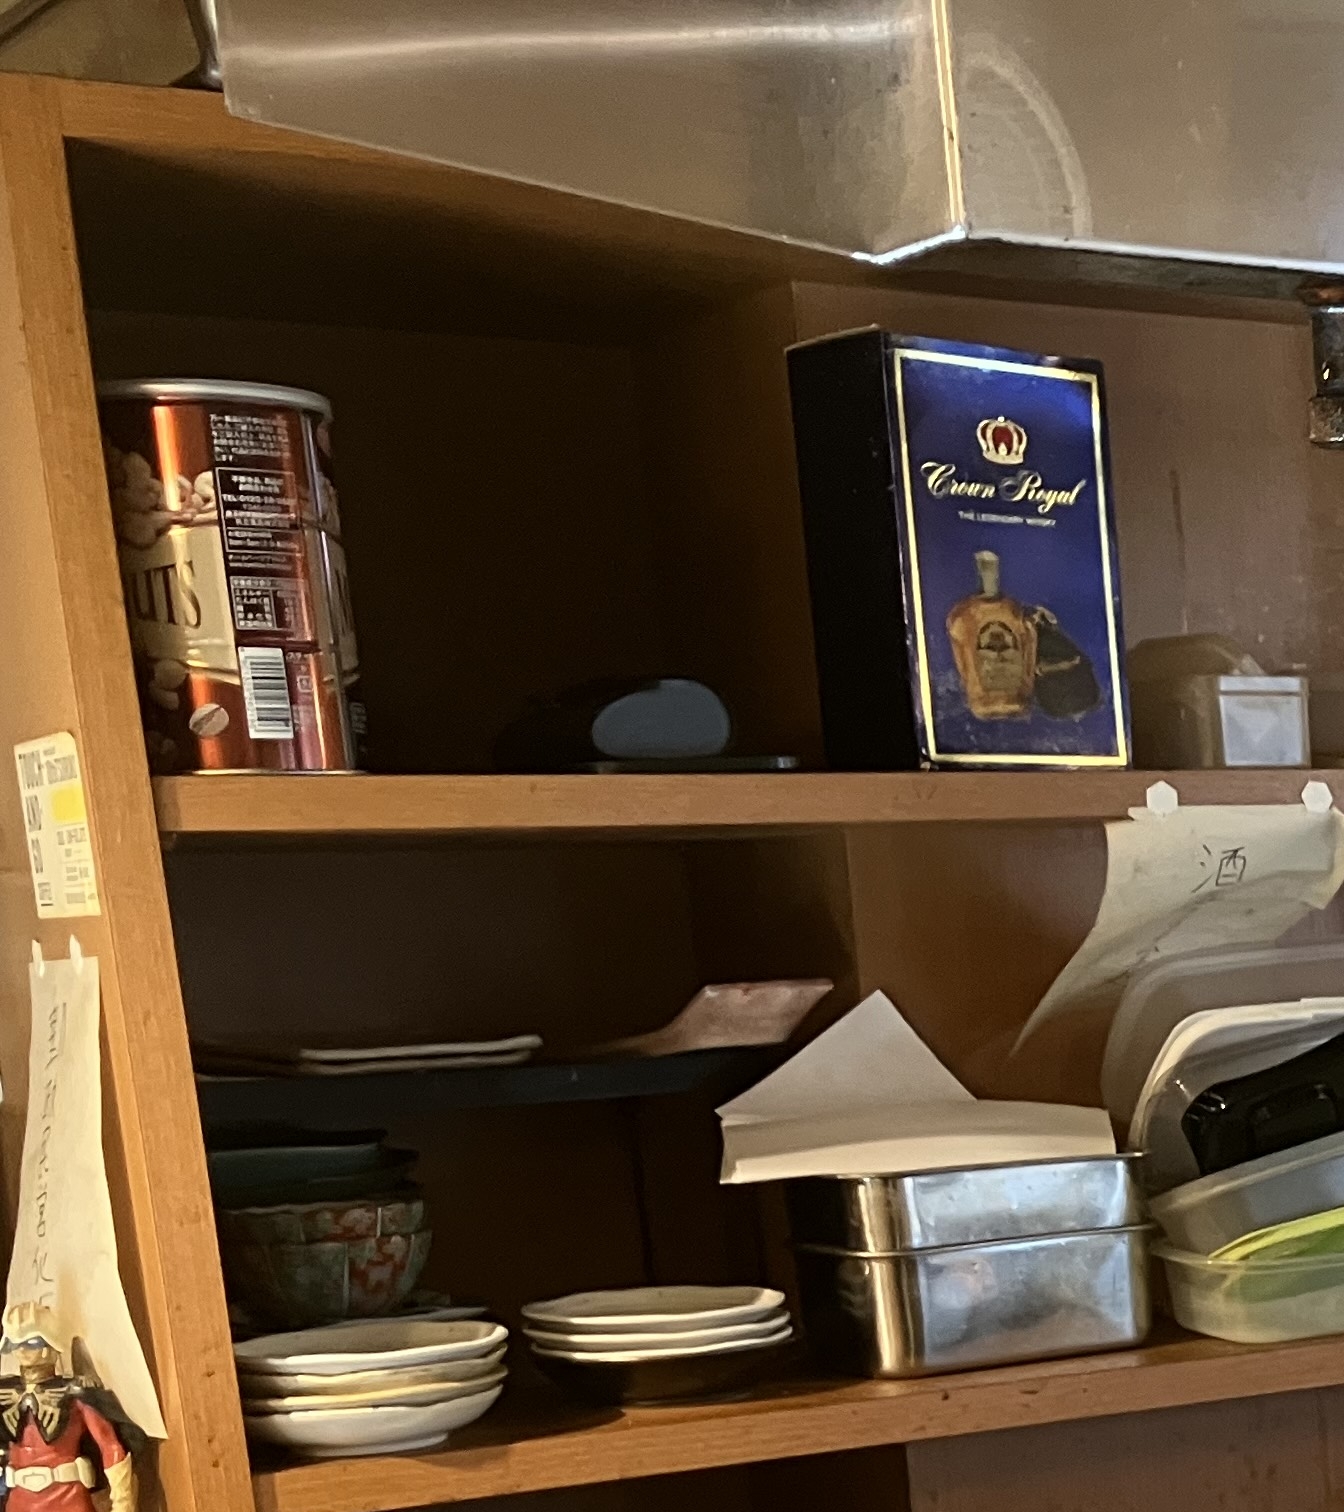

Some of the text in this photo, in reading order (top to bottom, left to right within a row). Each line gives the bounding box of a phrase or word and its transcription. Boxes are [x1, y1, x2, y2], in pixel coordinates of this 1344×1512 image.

[920, 461, 1087, 514] Crown Royal
[1192, 844, 1247, 894] 酒
